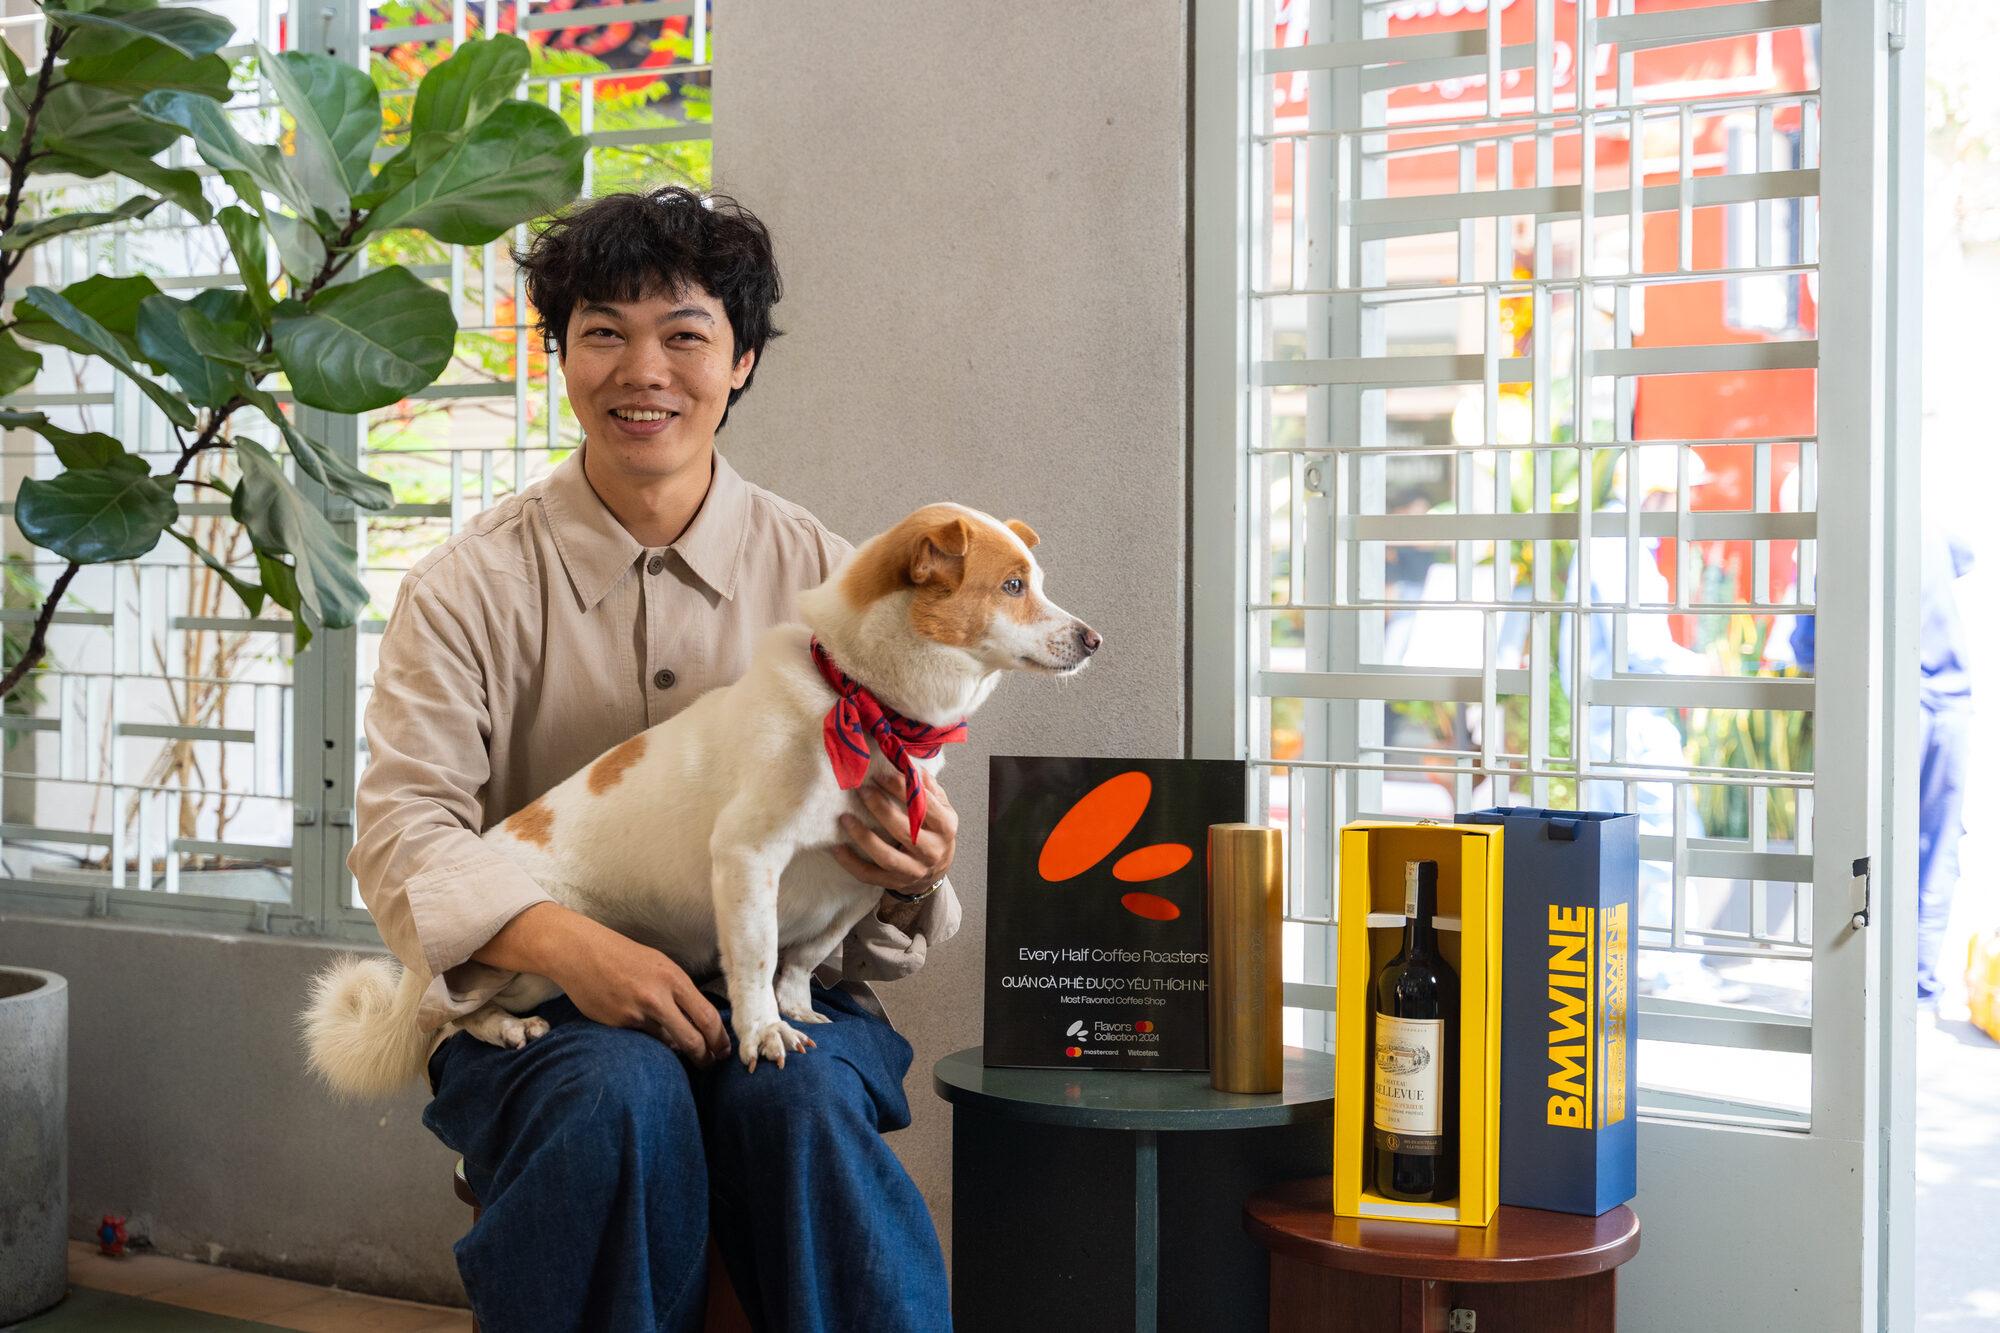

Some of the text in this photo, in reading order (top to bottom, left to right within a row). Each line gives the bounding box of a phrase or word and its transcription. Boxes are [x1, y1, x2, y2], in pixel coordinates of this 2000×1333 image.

[1019, 948, 1209, 964] Every Half Coffee Roasters
[1002, 975, 1038, 989] QUÁN
[1038, 976, 1057, 989] CÀ
[1059, 976, 1084, 989] PHÊ
[1127, 977, 1151, 990] YÊU
[1153, 977, 1191, 991] THÍCH
[1060, 995, 1166, 1006] Most Favored Coffee Shop
[1547, 904, 1587, 1129] BMWINE
[1094, 1021, 1132, 1031] Flavors
[1094, 1032, 1160, 1042] Collection 2024
